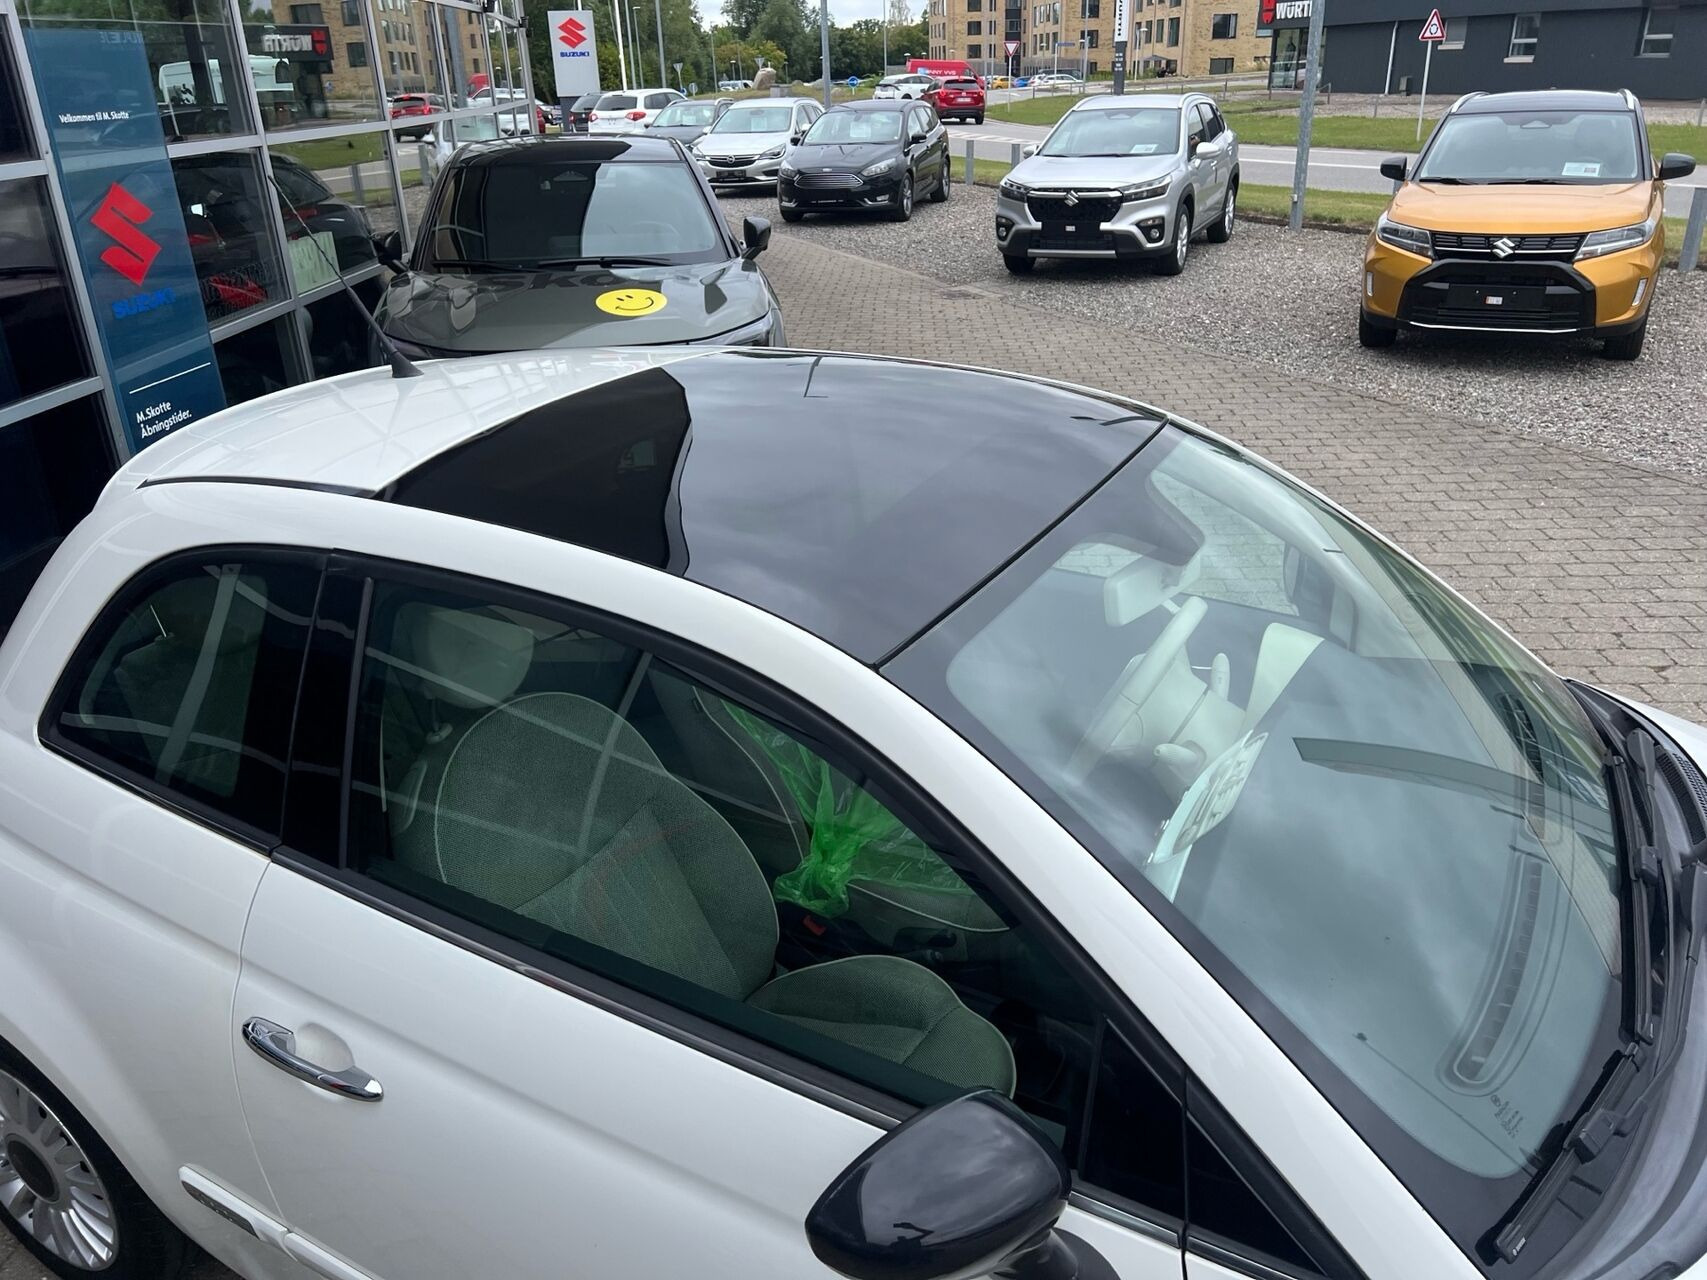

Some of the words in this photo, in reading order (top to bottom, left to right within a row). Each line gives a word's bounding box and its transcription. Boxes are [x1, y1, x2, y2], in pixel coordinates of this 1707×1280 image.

[59, 114, 95, 123] Velkommen
[102, 112, 110, 120] M.
[110, 111, 129, 120] Skotte
[141, 410, 192, 439] Åbningstider.
